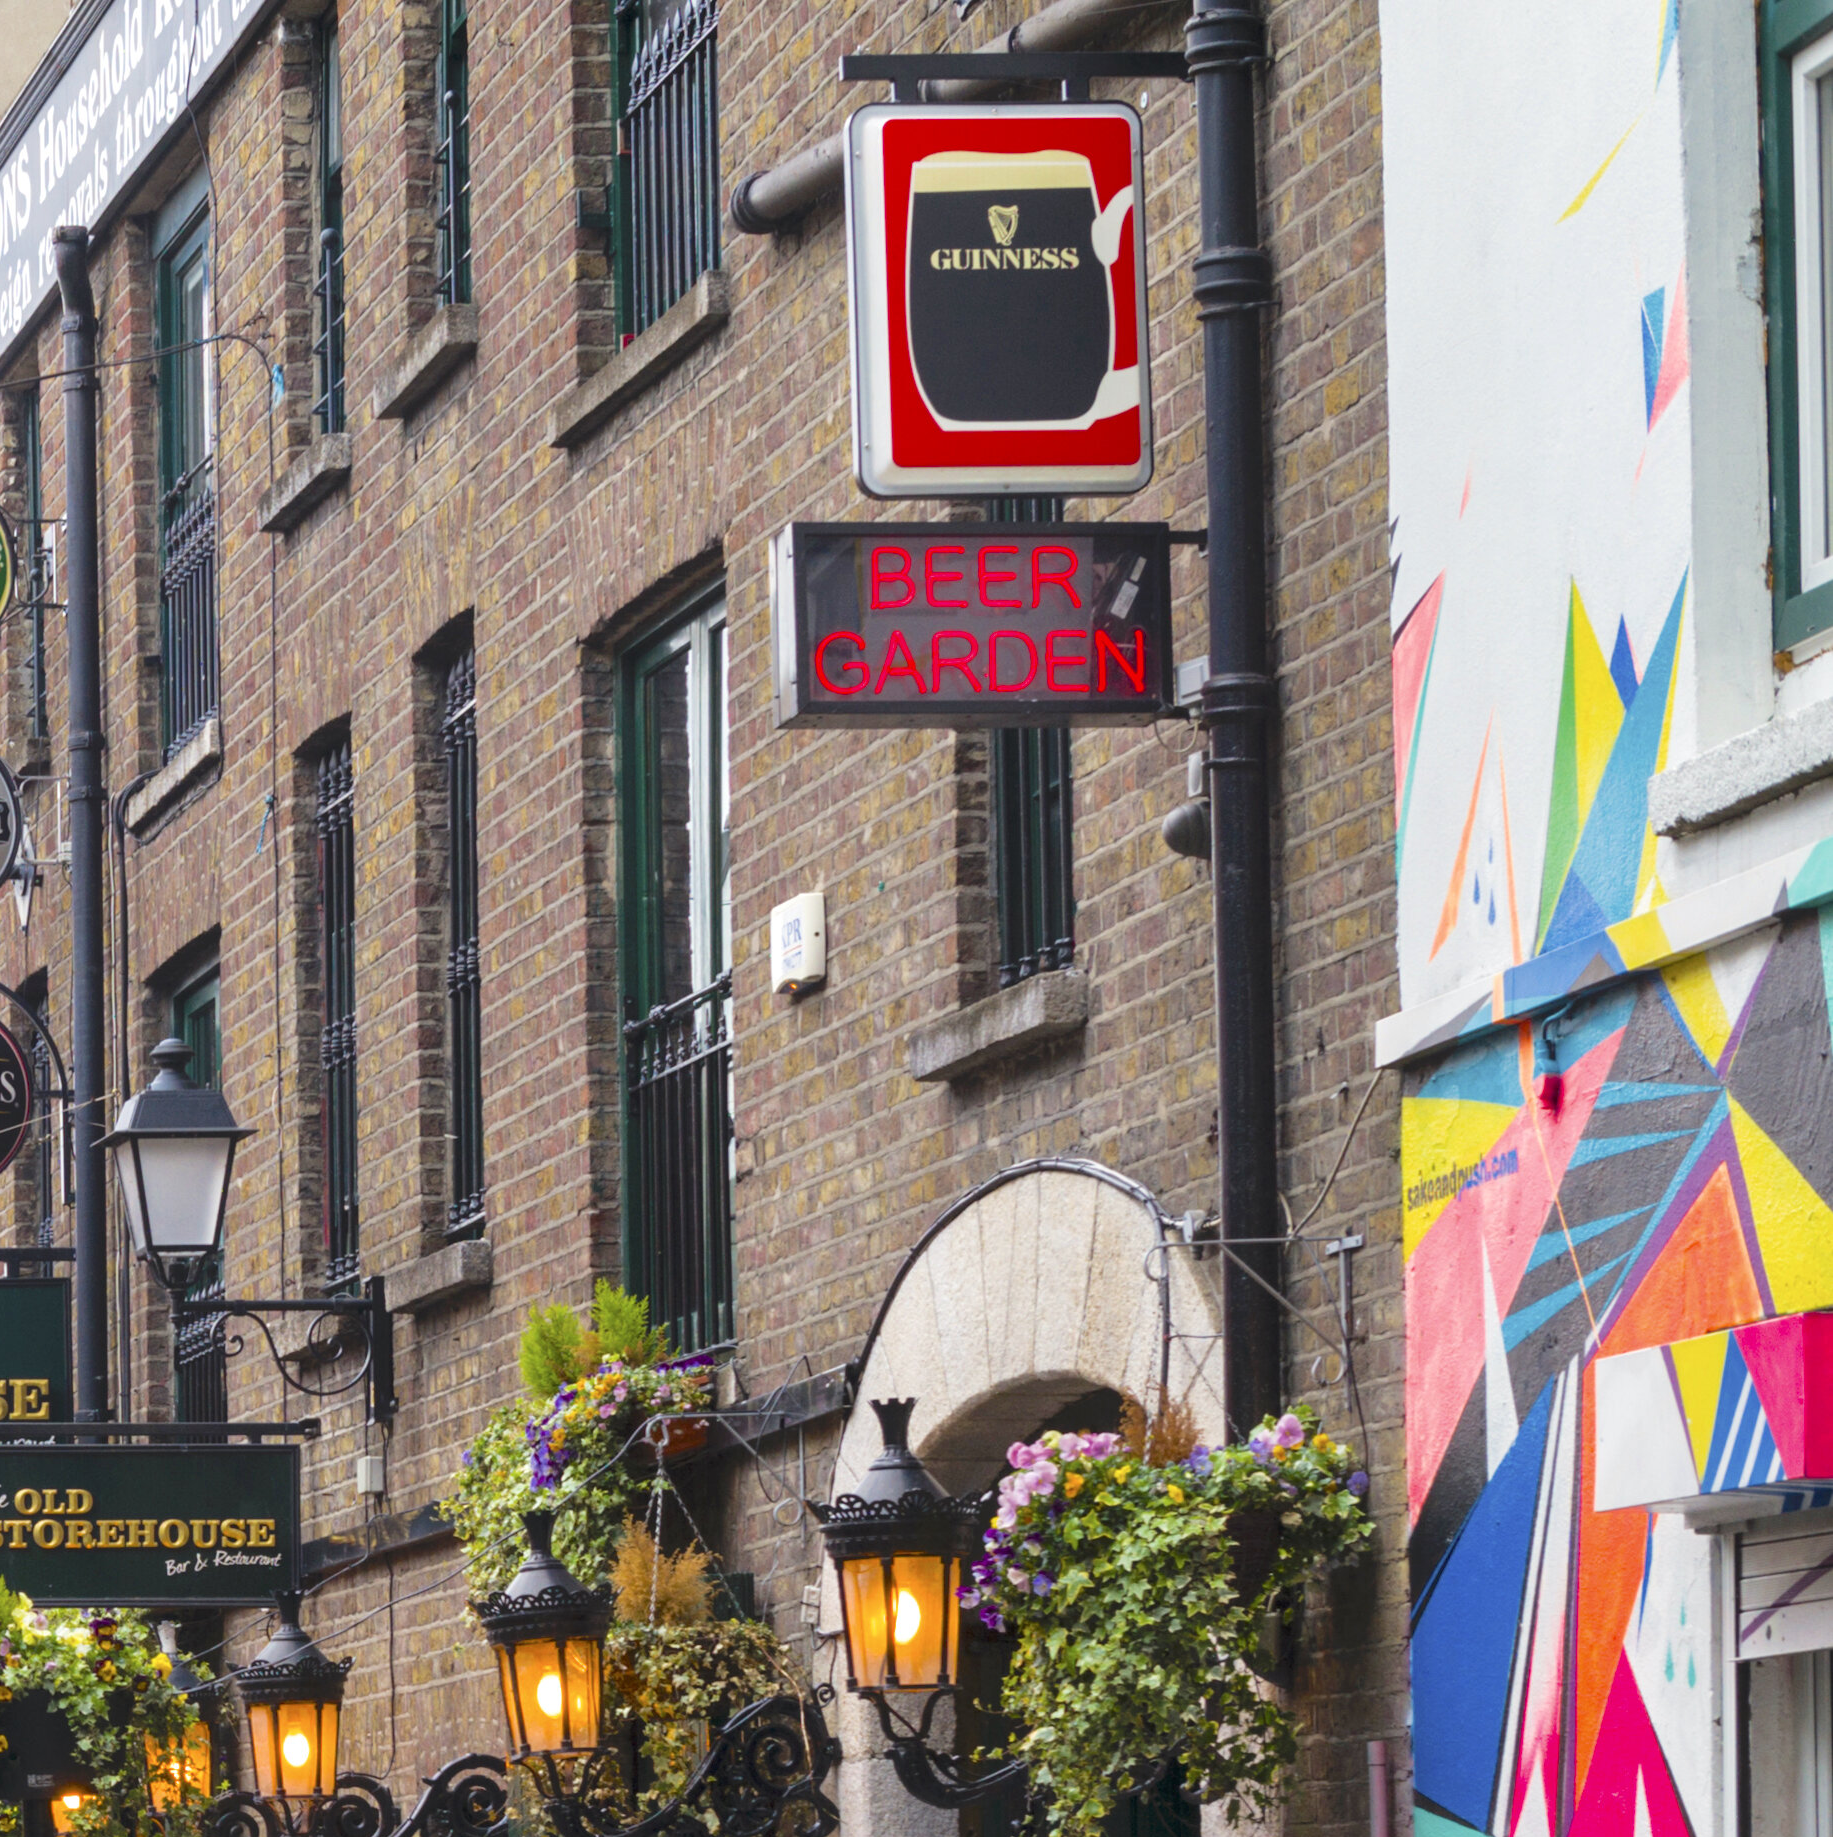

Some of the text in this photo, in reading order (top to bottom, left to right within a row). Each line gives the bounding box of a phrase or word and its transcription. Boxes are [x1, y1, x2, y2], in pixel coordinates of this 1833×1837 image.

[116, 2, 222, 175] throughout
[930, 247, 1080, 270] GUINNESS
[870, 545, 1082, 610] BEER
[813, 628, 1146, 694] GARDEN
[13, 1487, 94, 1516] OLD
[165, 1551, 283, 1576] Bar Restaurant
